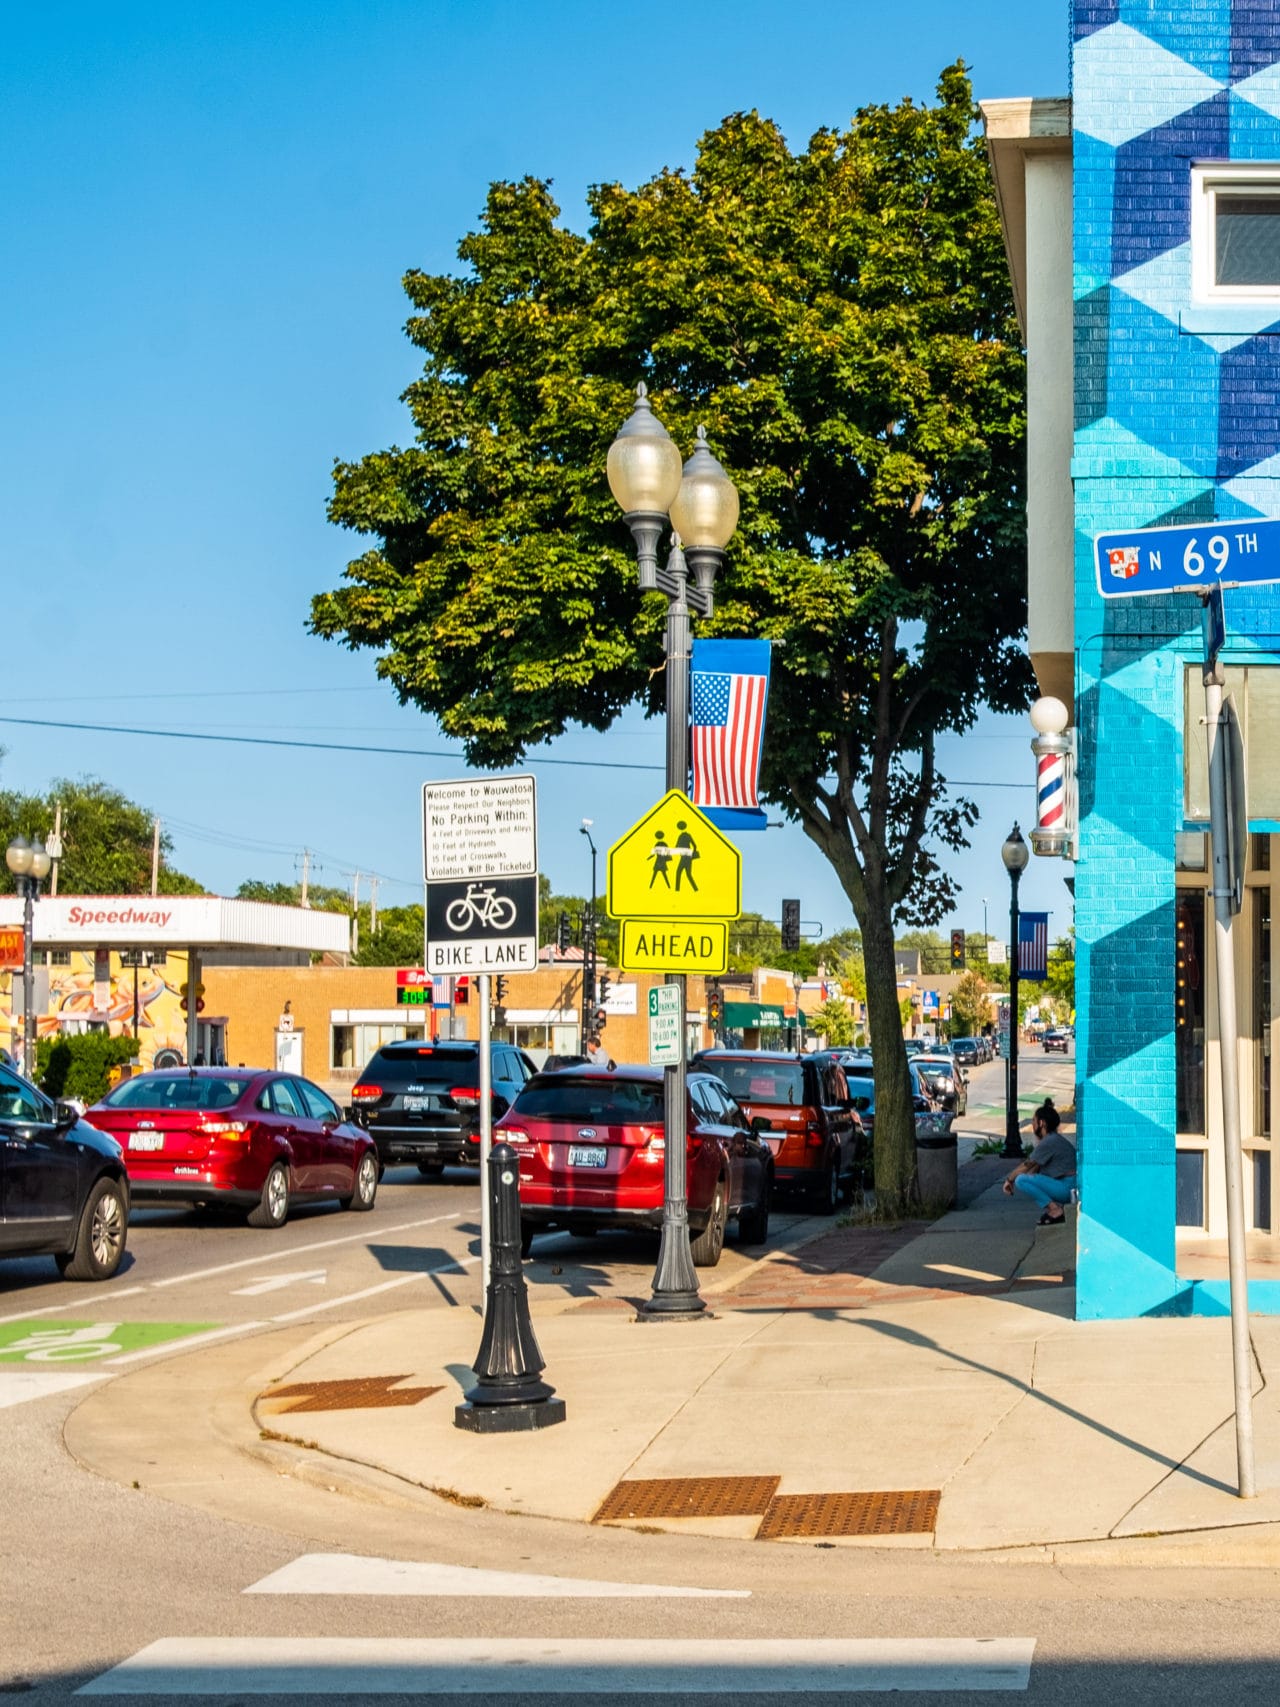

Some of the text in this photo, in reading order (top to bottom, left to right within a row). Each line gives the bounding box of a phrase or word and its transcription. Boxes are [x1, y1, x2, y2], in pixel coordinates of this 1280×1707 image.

[1150, 551, 1162, 571] N
[1183, 533, 1258, 577] 69TH
[427, 784, 533, 800] Welcome to Wauwatosa
[429, 798, 531, 812] Please Respect Our Neighbors
[432, 810, 528, 826] No Parking Within:
[440, 830, 453, 838] Feet
[465, 827, 497, 837] Driveways
[499, 826, 511, 834] and
[513, 824, 532, 833] Alleys
[468, 839, 497, 849] Hydrants
[443, 854, 457, 862] Feet
[460, 853, 467, 861] of
[470, 851, 507, 861] Crosswalks
[431, 861, 531, 876] Violators Will Be Ticketed
[68, 906, 172, 927] Speedway
[635, 934, 713, 957] AHEAD
[435, 944, 528, 966] BIKE LANE
[650, 993, 657, 1013] 3
[658, 1001, 678, 1012] PARKING
